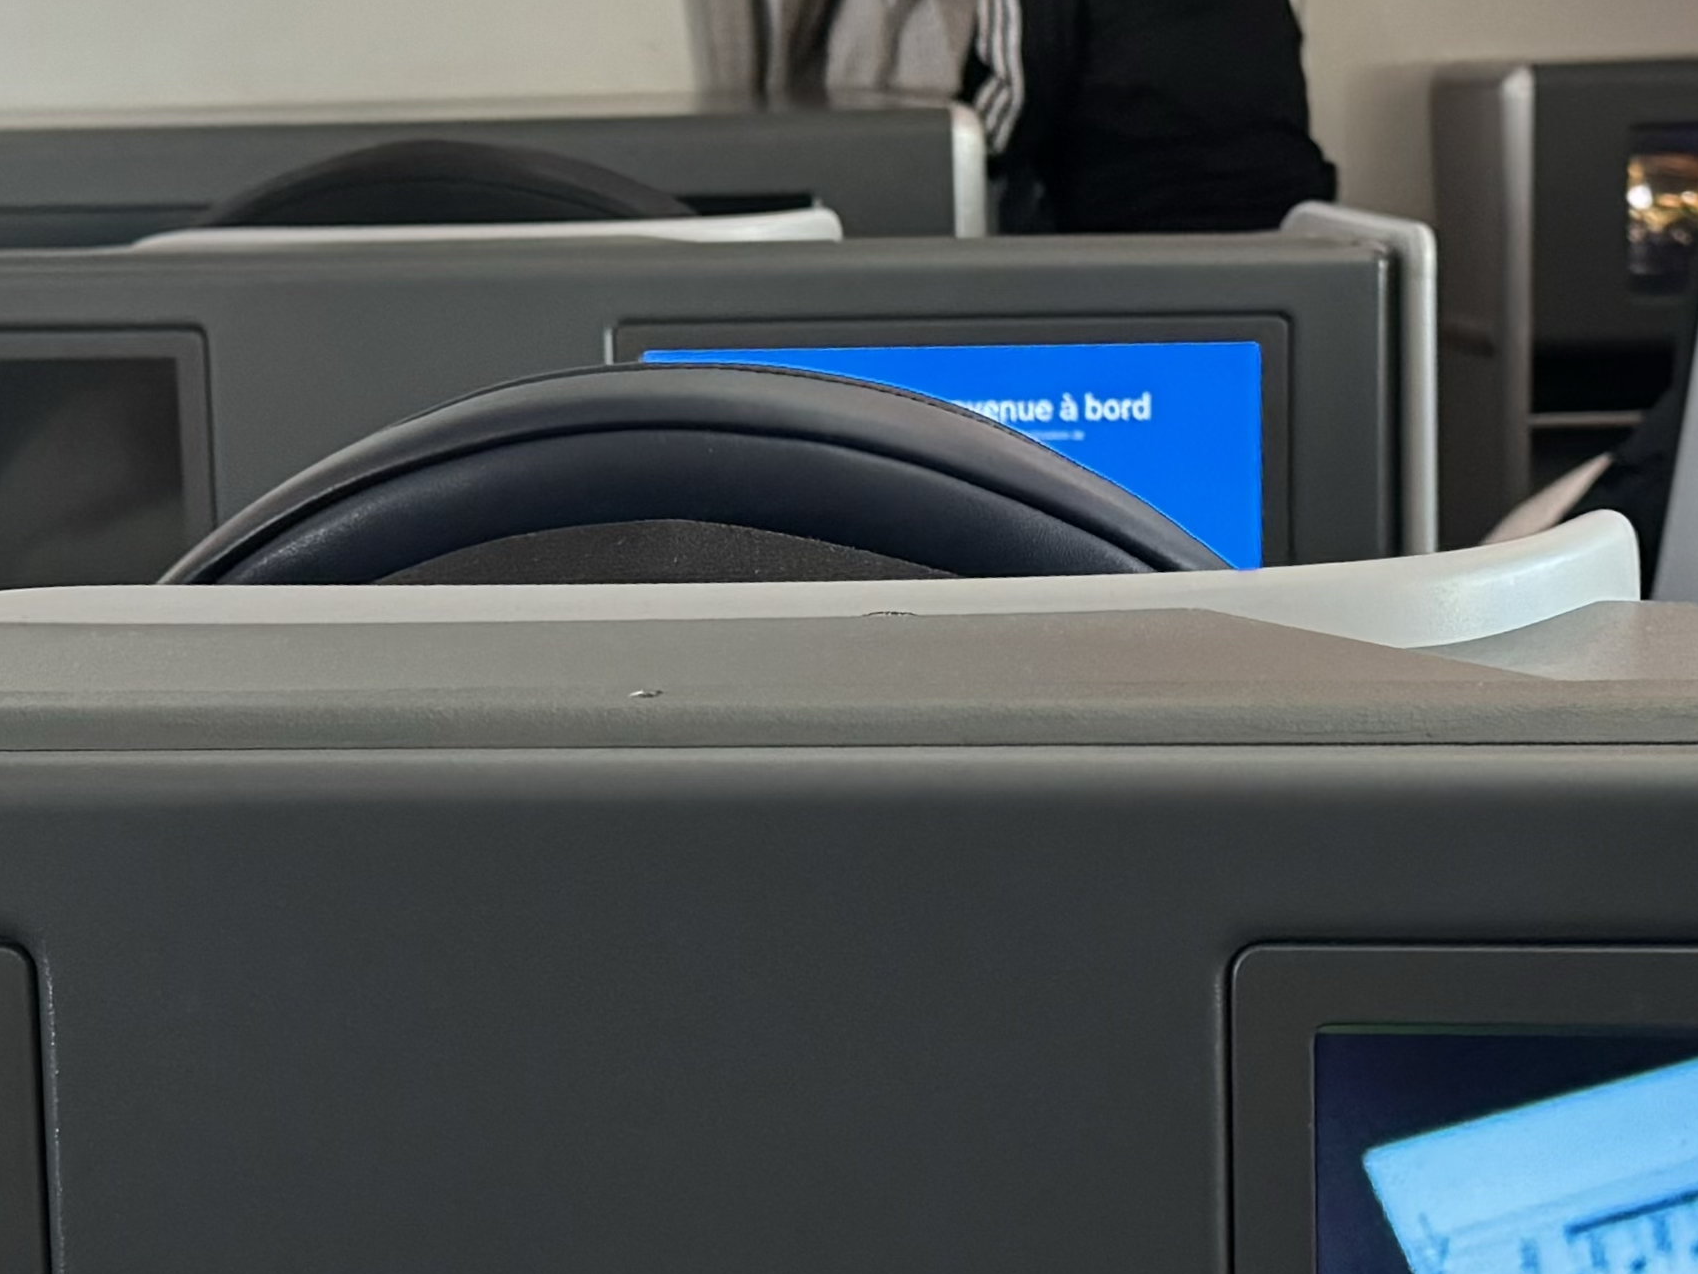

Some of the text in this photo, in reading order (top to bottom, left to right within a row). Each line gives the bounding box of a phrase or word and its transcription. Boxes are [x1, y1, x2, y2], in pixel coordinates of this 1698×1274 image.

[952, 391, 1152, 422] venue à bord
